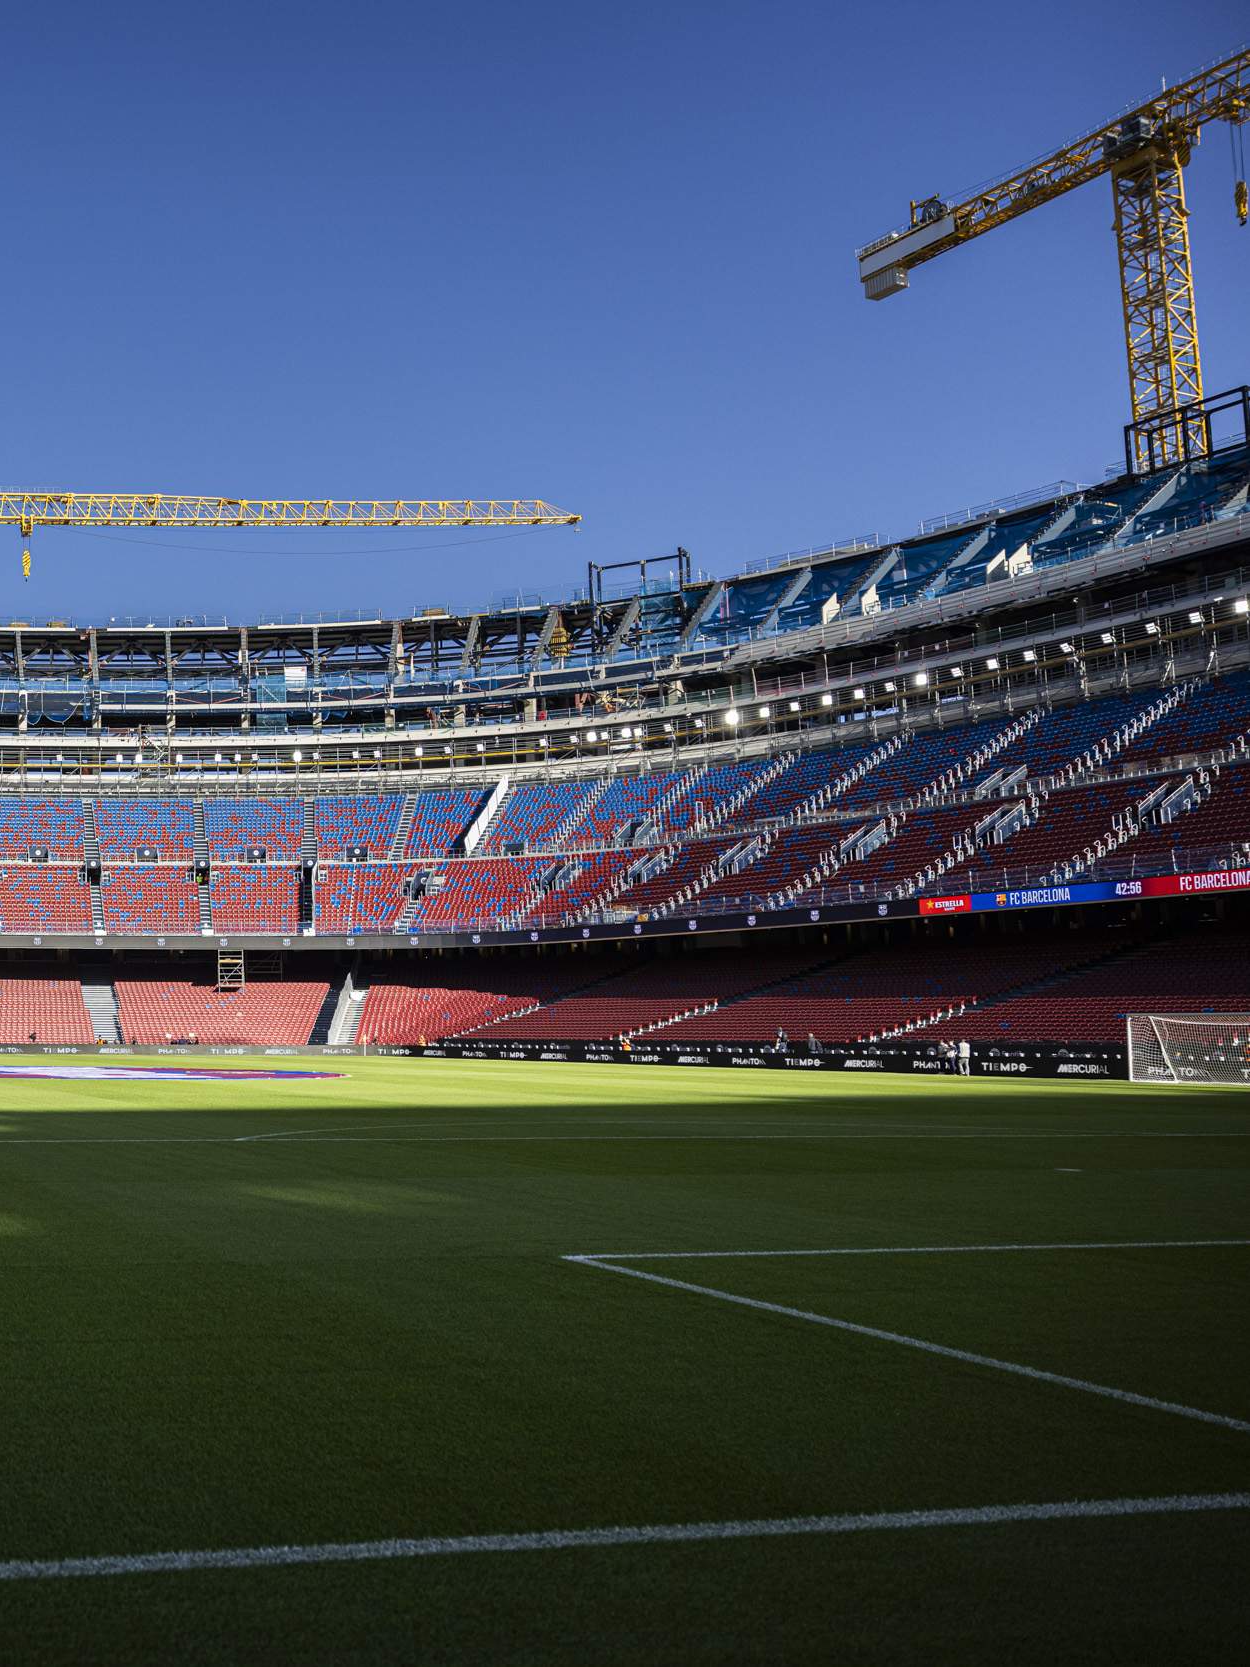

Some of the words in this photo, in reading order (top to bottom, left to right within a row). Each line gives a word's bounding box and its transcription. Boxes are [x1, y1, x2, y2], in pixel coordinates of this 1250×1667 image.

[1115, 881, 1142, 895] 42:56
[1179, 876, 1193, 891] FC
[1010, 892, 1021, 905] FC
[1021, 887, 1070, 903] BARCELONA
[935, 899, 964, 908] ESTRELLA
[43, 1046, 81, 1054] TIMPO
[499, 1051, 528, 1059] TIMPO
[629, 1055, 662, 1063] TIEMPO
[677, 1055, 710, 1064] MERCURIAL
[731, 1057, 767, 1065] PHANTOM
[785, 1058, 826, 1067] TIEMPO
[844, 1059, 885, 1068] MERCURIAL
[913, 1060, 951, 1069] PHANT
[981, 1062, 1034, 1072] TIEMPO
[1057, 1063, 1110, 1074] MERCURIAL
